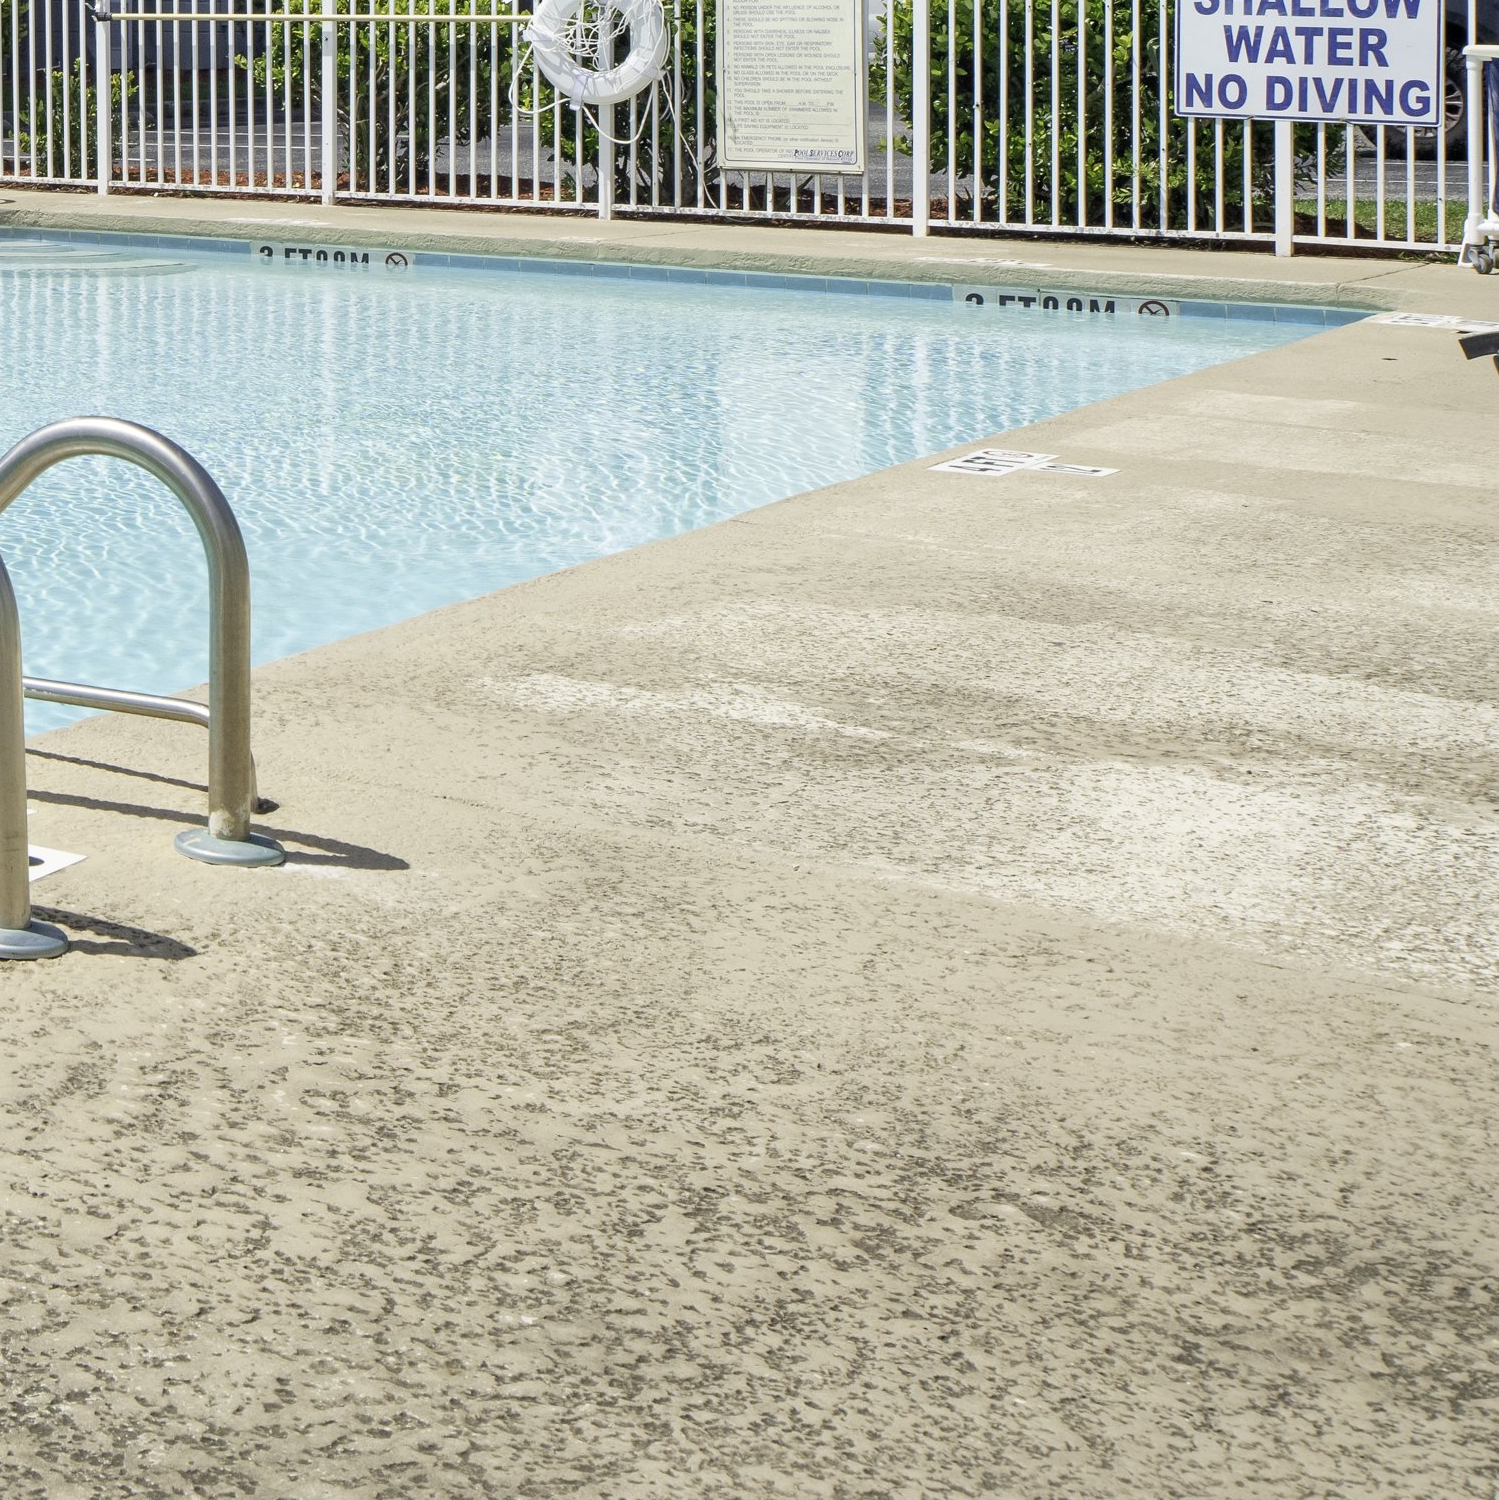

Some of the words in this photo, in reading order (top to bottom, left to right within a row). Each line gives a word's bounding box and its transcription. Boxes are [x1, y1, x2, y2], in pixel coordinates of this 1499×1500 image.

[1223, 25, 1389, 68] WATER
[1185, 73, 1248, 110] NO
[1266, 75, 1431, 117] DIVING
